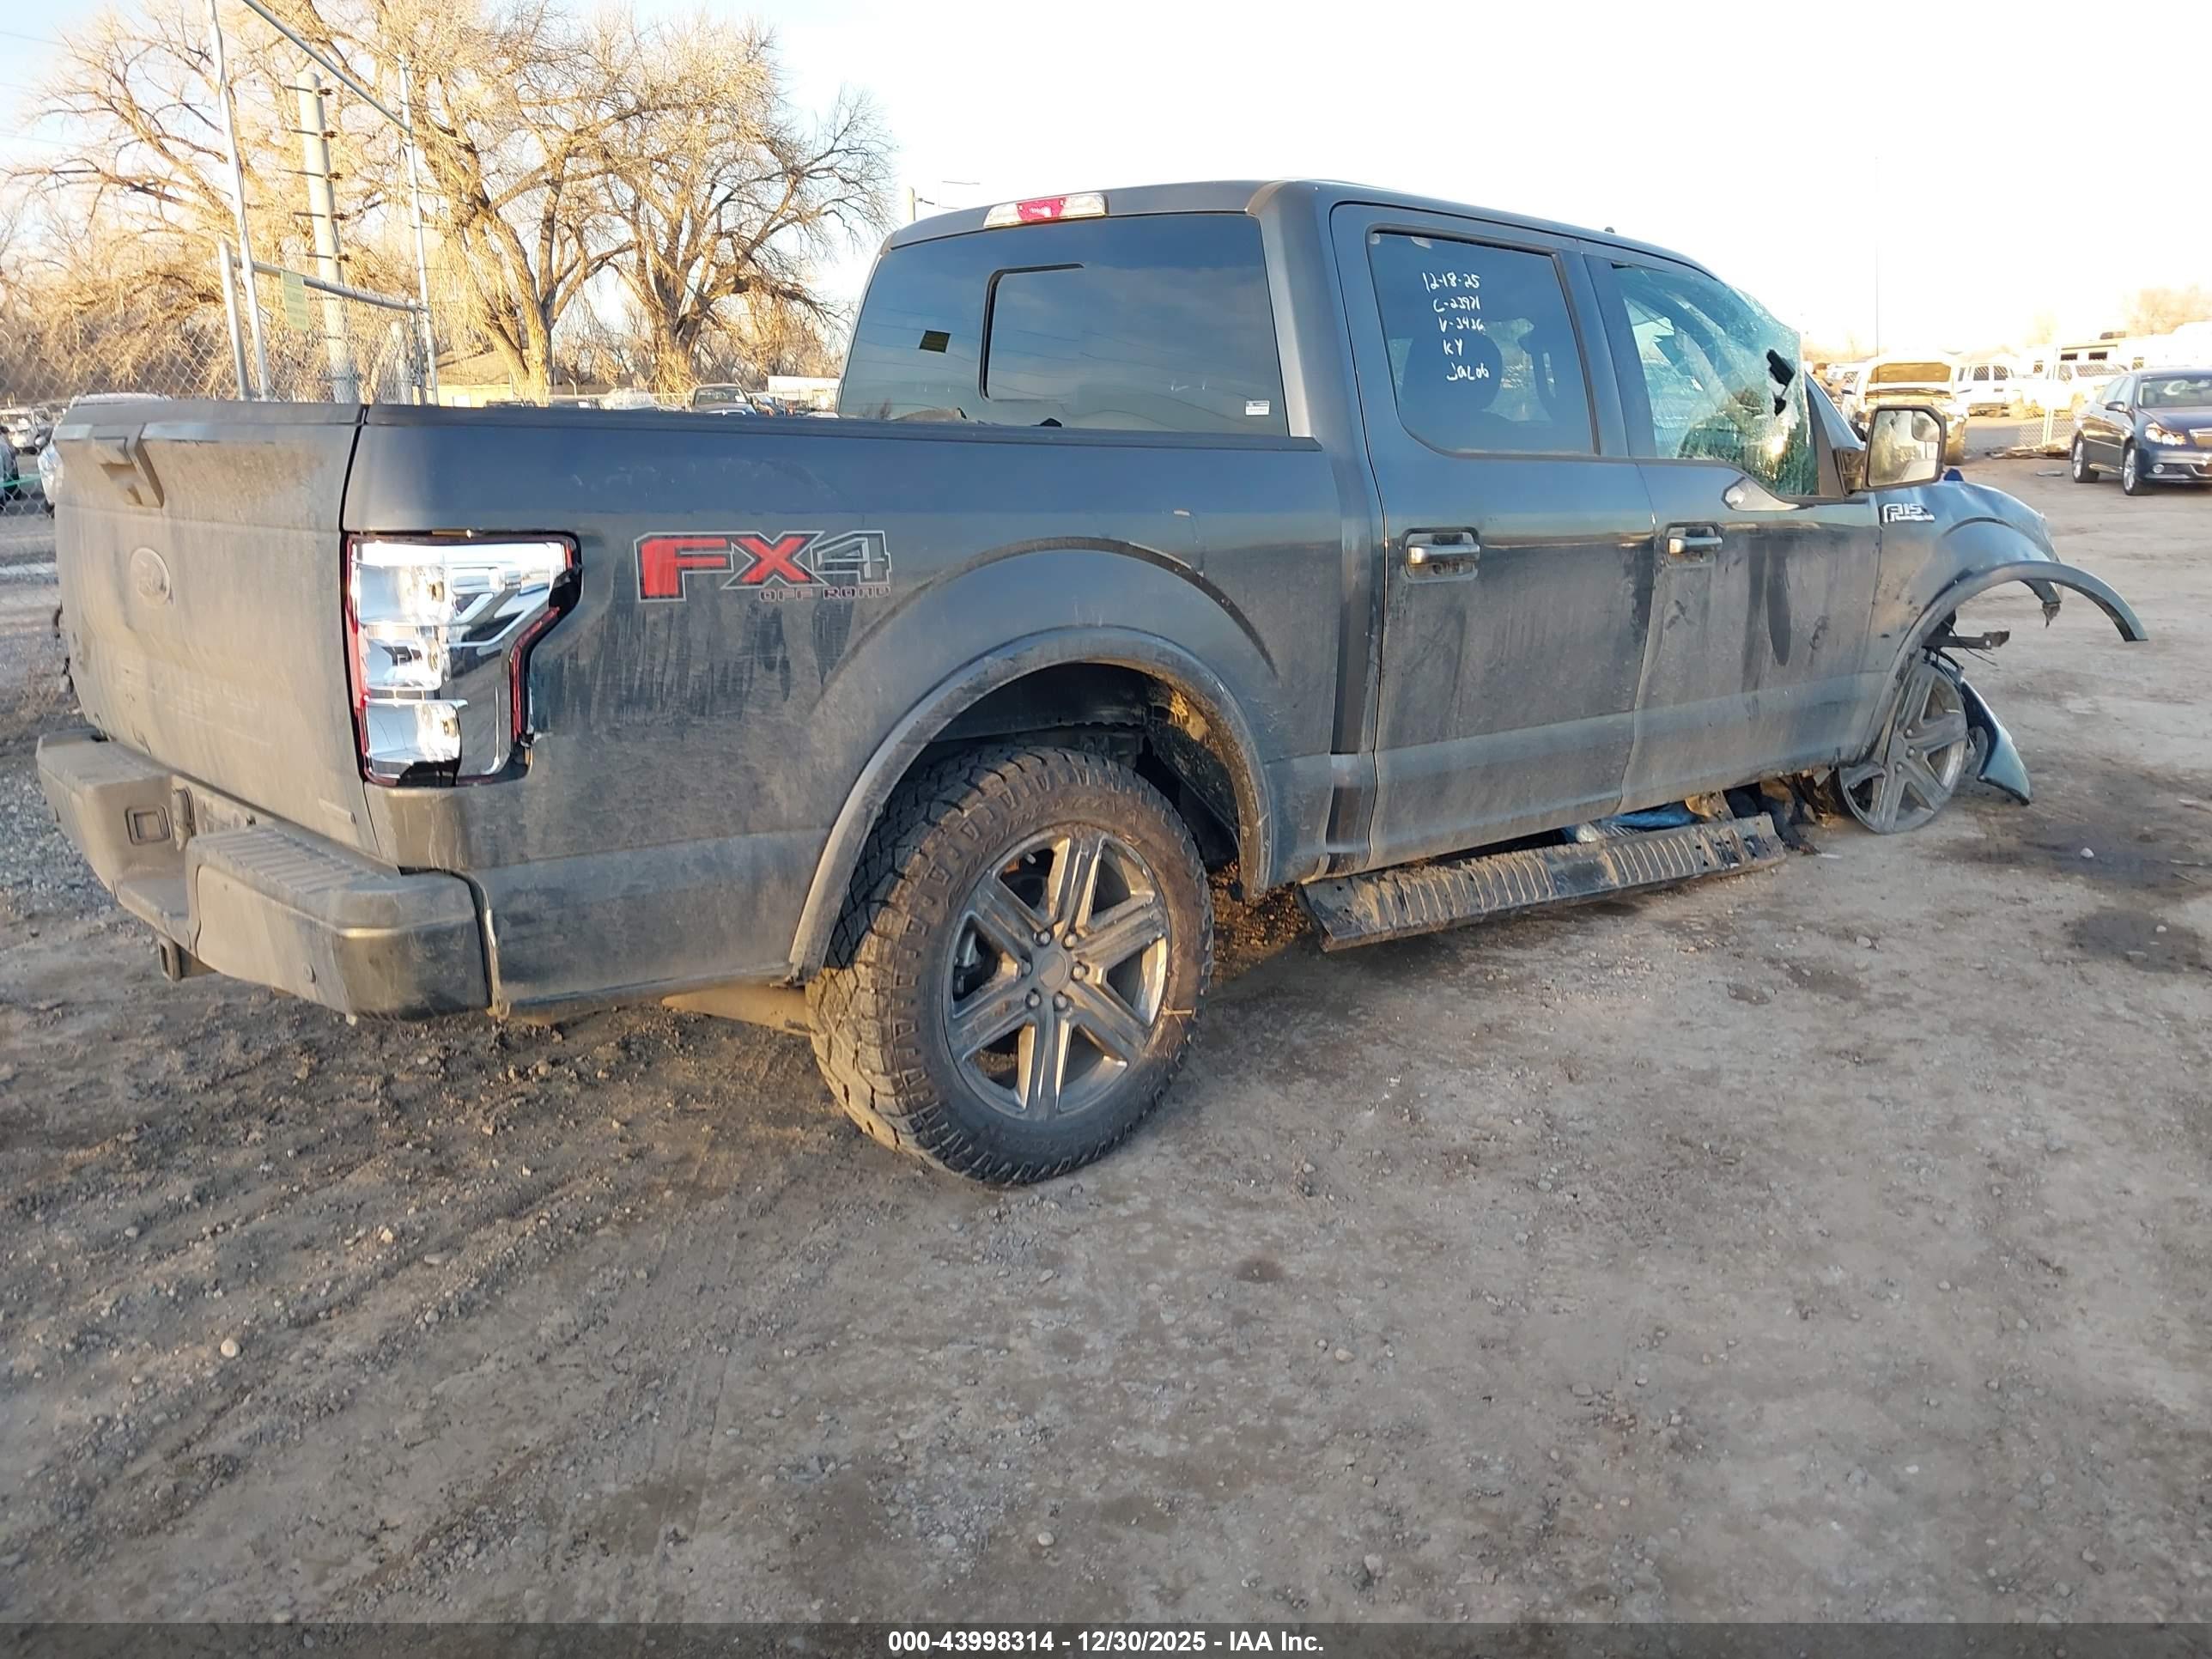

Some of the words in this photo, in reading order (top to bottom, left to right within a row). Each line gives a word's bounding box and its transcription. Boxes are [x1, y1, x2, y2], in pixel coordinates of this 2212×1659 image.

[634, 530, 892, 603] FX4
[759, 589, 813, 601] OFF
[823, 586, 891, 600] ROAD
